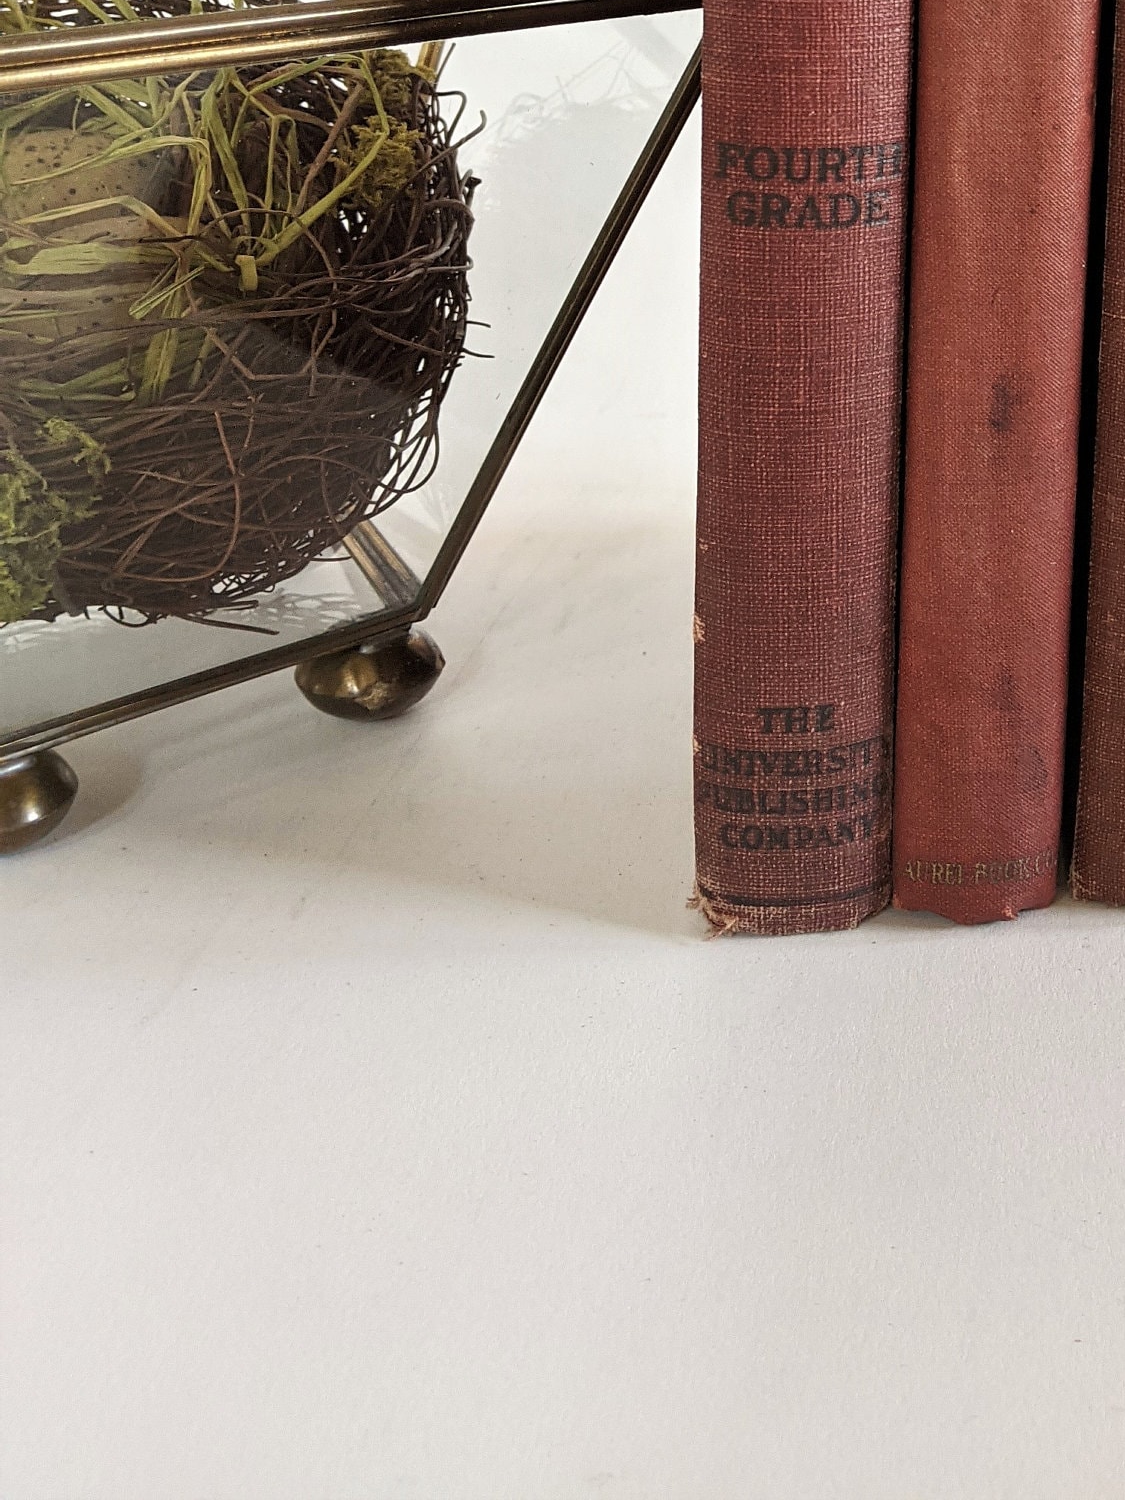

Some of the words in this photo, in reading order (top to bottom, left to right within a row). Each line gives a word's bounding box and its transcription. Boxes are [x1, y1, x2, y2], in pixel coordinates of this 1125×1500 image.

[714, 142, 902, 184] FOURTH
[727, 190, 890, 230] GRADE
[757, 704, 836, 734] THE
[720, 815, 878, 851] COMPANY
